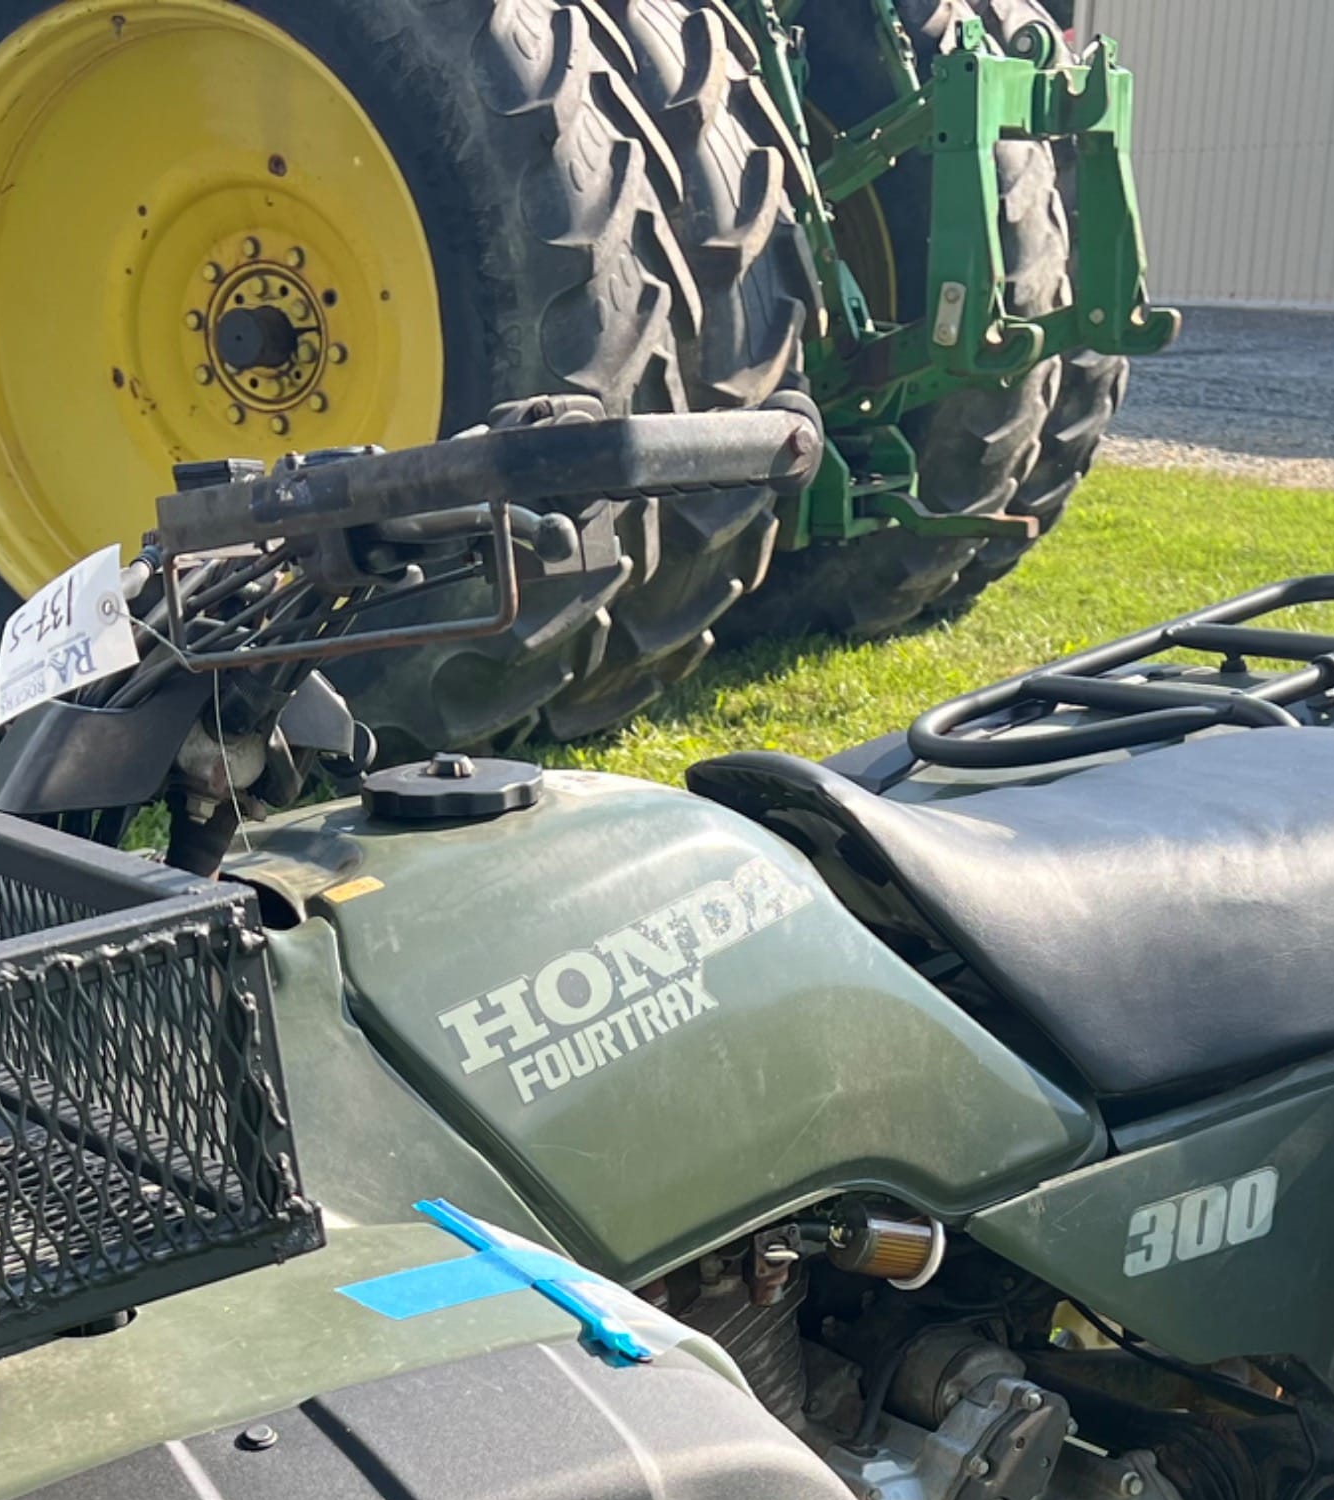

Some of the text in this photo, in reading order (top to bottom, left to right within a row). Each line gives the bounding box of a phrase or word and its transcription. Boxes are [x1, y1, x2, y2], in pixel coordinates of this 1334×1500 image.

[438, 857, 814, 1075] HONDA
[508, 972, 719, 1104] FOURTRAX
[1123, 1167, 1279, 1277] 300
